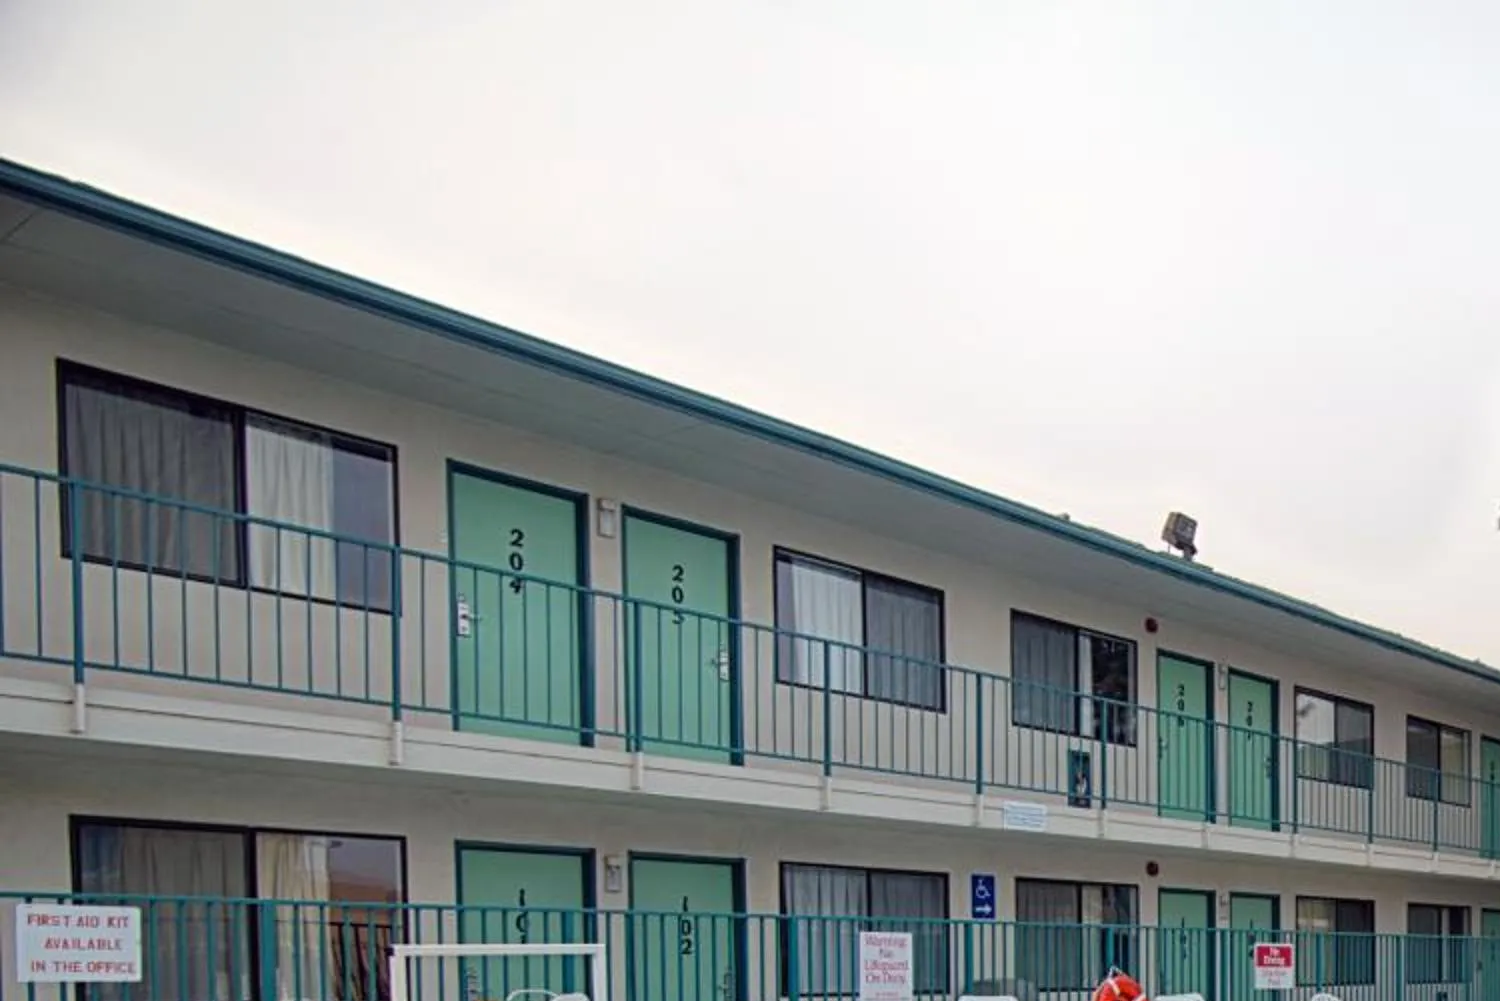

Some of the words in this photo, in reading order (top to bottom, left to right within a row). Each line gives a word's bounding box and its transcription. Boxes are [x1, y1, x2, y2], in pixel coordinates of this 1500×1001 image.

[508, 527, 526, 595] 204
[27, 912, 71, 928] FIRST
[76, 914, 99, 928] AID
[106, 915, 130, 928] KIT
[680, 896, 693, 955] 102
[44, 937, 123, 950] AVAILABLE
[31, 959, 47, 972] IN
[52, 960, 83, 973] THE
[86, 961, 136, 974] OFFICE
